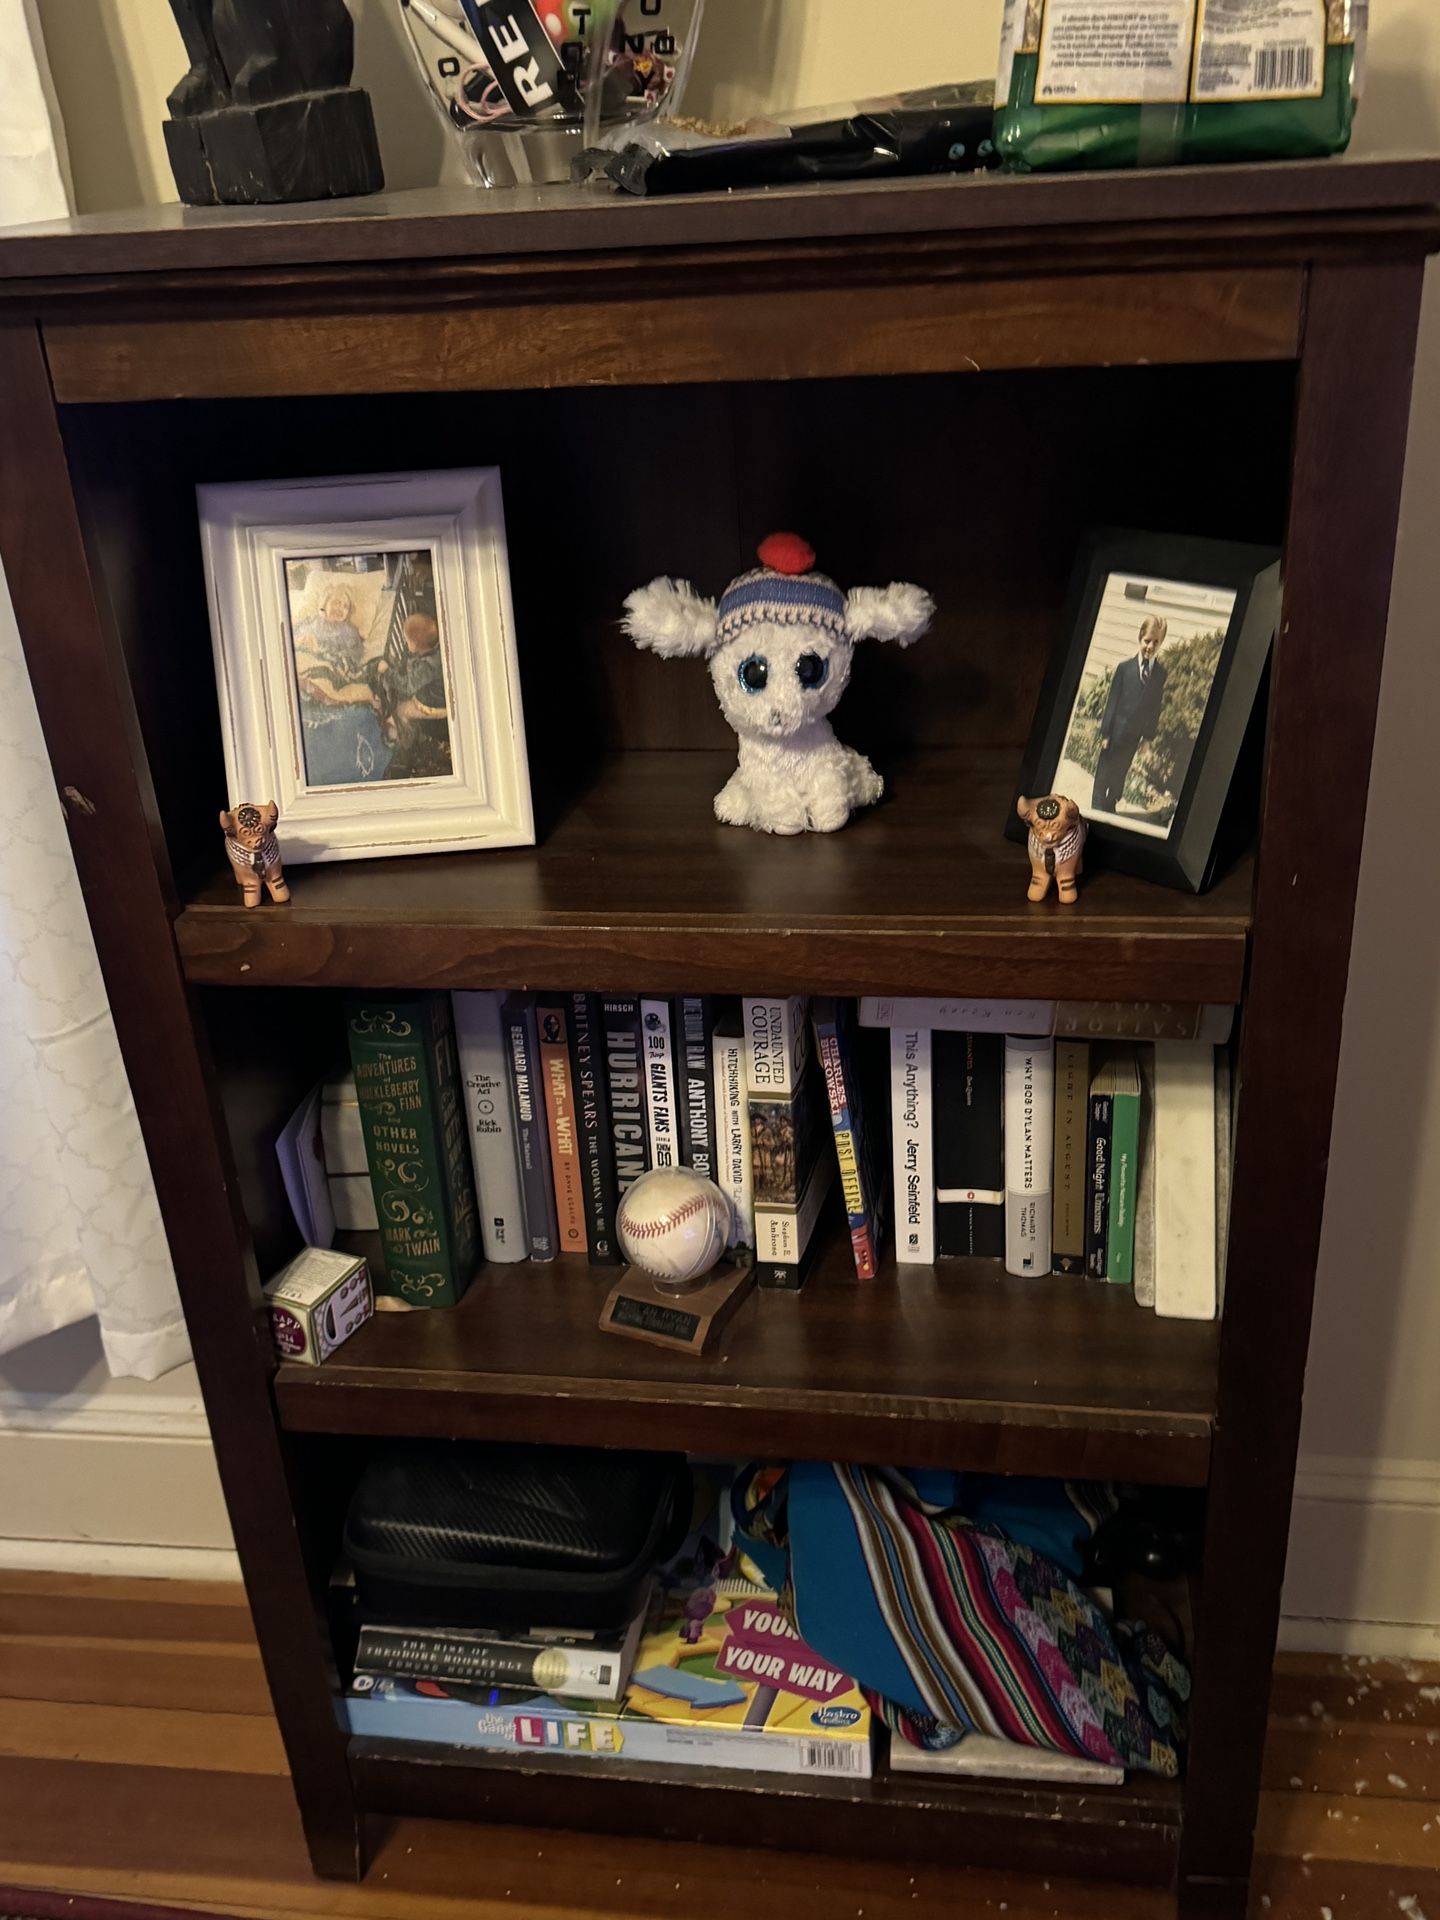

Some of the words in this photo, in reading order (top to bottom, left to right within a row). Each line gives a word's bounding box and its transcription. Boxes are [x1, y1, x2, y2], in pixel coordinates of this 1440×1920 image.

[474, 0, 553, 108] RE
[604, 1003, 634, 1013] HIRSCH
[573, 993, 592, 1064] BRITNEY
[648, 1035, 665, 1050] 100
[510, 1025, 527, 1073] BERNARD
[686, 1045, 706, 1069] RAW
[751, 1005, 771, 1084] COURAGE
[769, 1006, 785, 1084] UNDAUNTED
[905, 1032, 919, 1060] This
[356, 1056, 417, 1078] ADVENTURES
[549, 1058, 566, 1099] WHAT
[727, 1047, 740, 1107] HITCHHIKING
[820, 1038, 841, 1116] BUKOWSKI
[829, 1037, 847, 1105] CHARLES
[1024, 1056, 1033, 1080] WHY
[1065, 1054, 1075, 1101] LIGHT
[466, 1080, 501, 1088] Creative
[516, 1073, 533, 1122] MALAMUD
[650, 1063, 668, 1103] GIANTS
[902, 1063, 920, 1129] Anything?
[1024, 1084, 1033, 1105] BOB
[400, 1095, 422, 1111] FINN
[580, 1071, 598, 1129] SPEARS
[687, 1078, 709, 1147] ANTHONY
[654, 1106, 670, 1133] FANS
[731, 1110, 739, 1125] WITH
[1024, 1108, 1033, 1142] DYLAN
[1065, 1109, 1073, 1124] IN
[373, 1124, 417, 1140] OTHER
[556, 1116, 573, 1156] WHAT
[588, 1135, 598, 1155] THE
[731, 1128, 742, 1156] LARRY
[834, 1131, 853, 1161] POST
[375, 1140, 420, 1155] NOVELS
[904, 1138, 920, 1172] Jerry
[1095, 1137, 1107, 1162] Good
[732, 1158, 743, 1184] DAVID
[1024, 1144, 1033, 1189] MATTERS
[1063, 1134, 1073, 1192] AUGUST
[1092, 1162, 1106, 1190] Night
[591, 1158, 603, 1200] WOMAN
[841, 1168, 864, 1214] OFFICE
[595, 1202, 603, 1215] IN
[907, 1174, 921, 1225] Seinfeld
[384, 1226, 412, 1242] MARK
[1020, 1207, 1028, 1238] THOMAS
[404, 1235, 441, 1258] TWAIN
[366, 1645, 439, 1663] THEODORE
[443, 1652, 523, 1671] ROOSEVELT
[401, 1639, 428, 1651] THE
[433, 1643, 465, 1655] RISE
[471, 1647, 489, 1657] OF
[387, 1658, 441, 1674] EDMUND
[447, 1665, 497, 1680] MORRIS
[724, 1645, 786, 1681] YOUR
[787, 1662, 844, 1694] WAY
[478, 1718, 516, 1736] Game
[817, 1705, 859, 1722] Hasbro
[519, 1717, 618, 1752] LIFE
